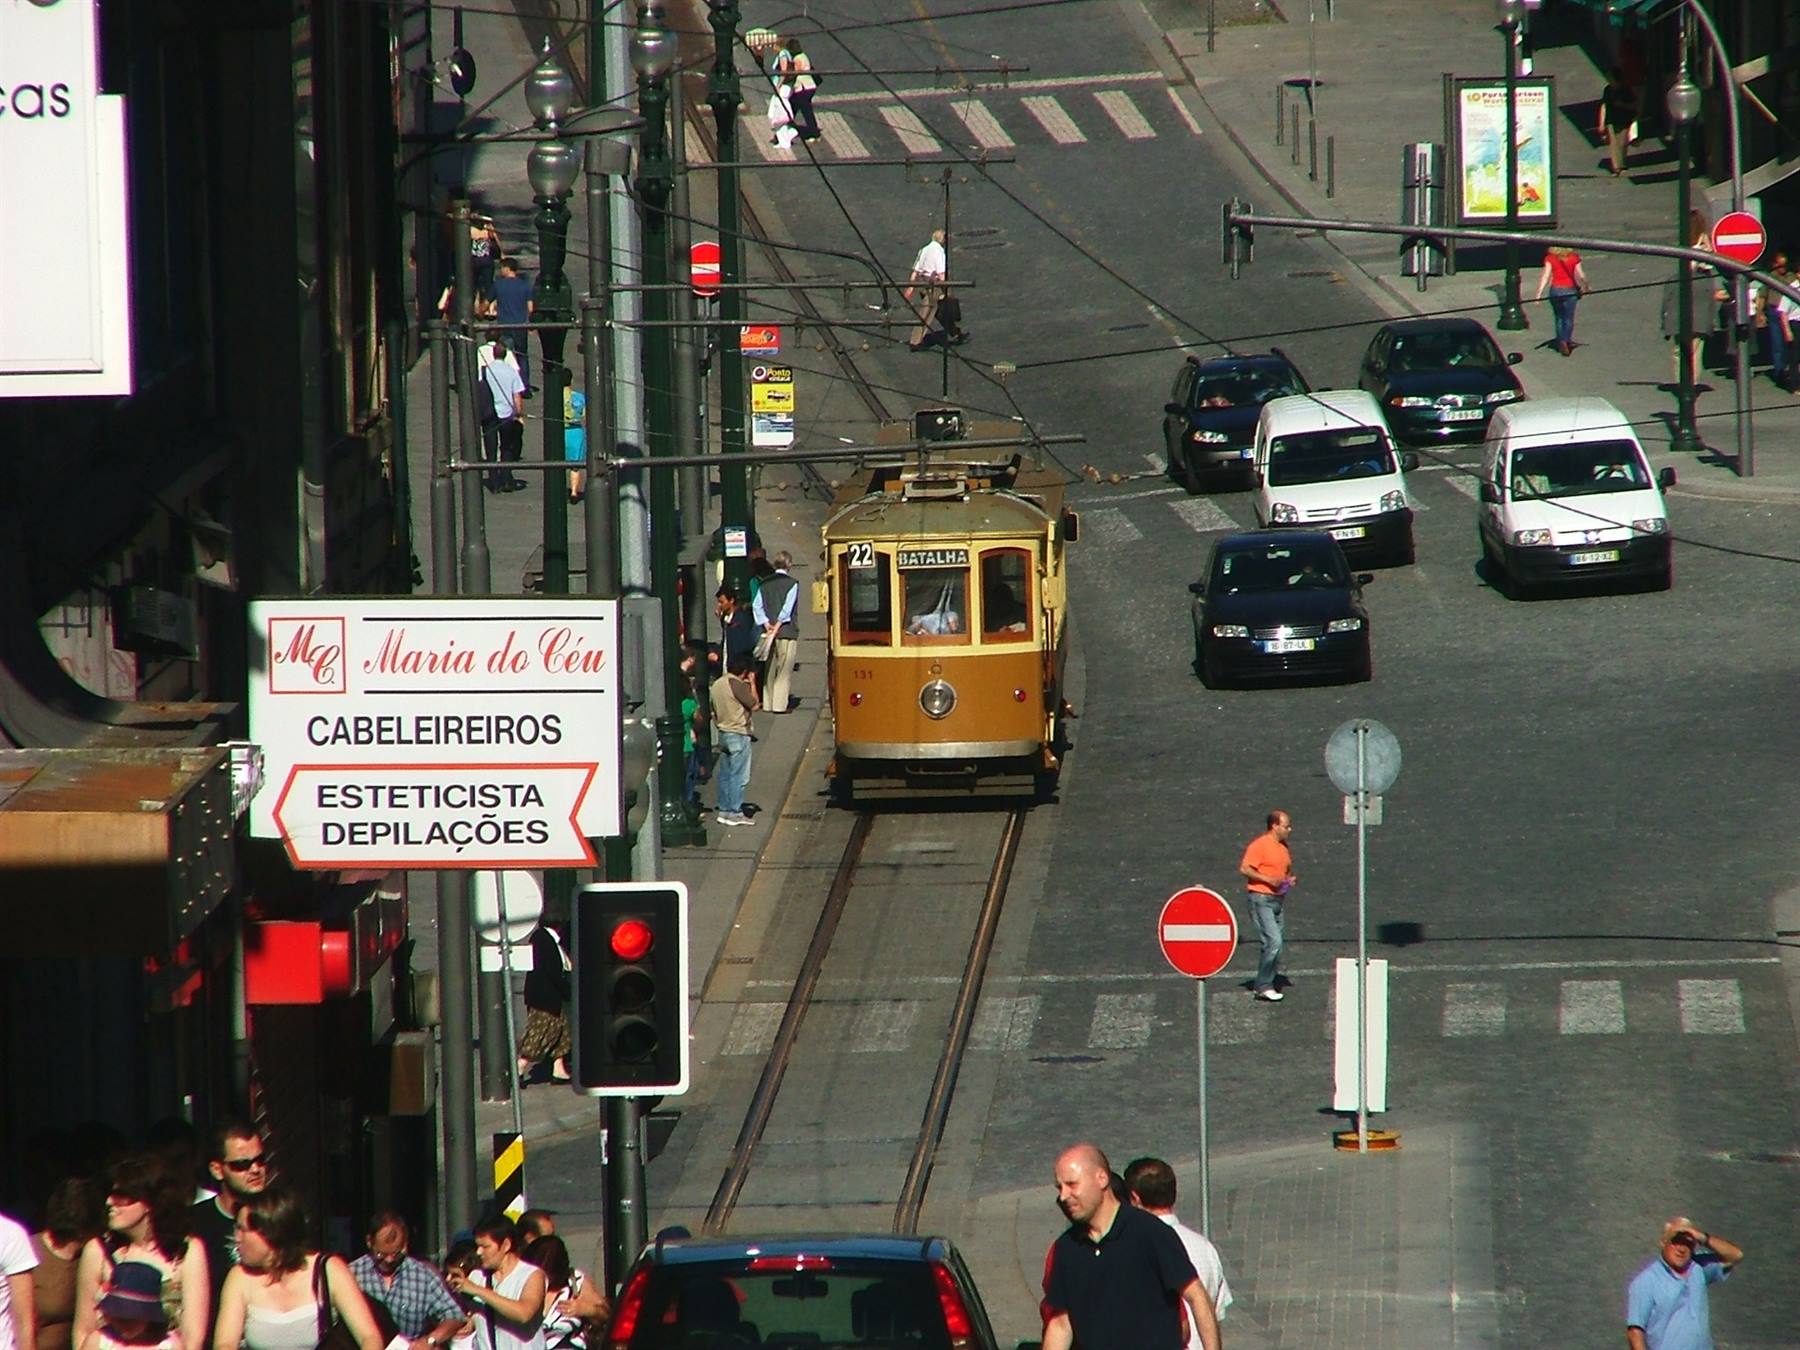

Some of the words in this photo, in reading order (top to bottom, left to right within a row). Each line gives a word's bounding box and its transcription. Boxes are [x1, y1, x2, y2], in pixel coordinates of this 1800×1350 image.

[0, 83, 70, 118] as
[850, 543, 873, 566] 22
[898, 550, 967, 566] BATALHA
[363, 628, 476, 674] Maria
[487, 630, 531, 674] do
[538, 626, 606, 674] Céu
[854, 669, 873, 681] 131
[307, 714, 563, 746] CABELEIREIROS
[316, 784, 545, 809] ESTETICISTA
[321, 813, 550, 853] DEPILAÇÕES
